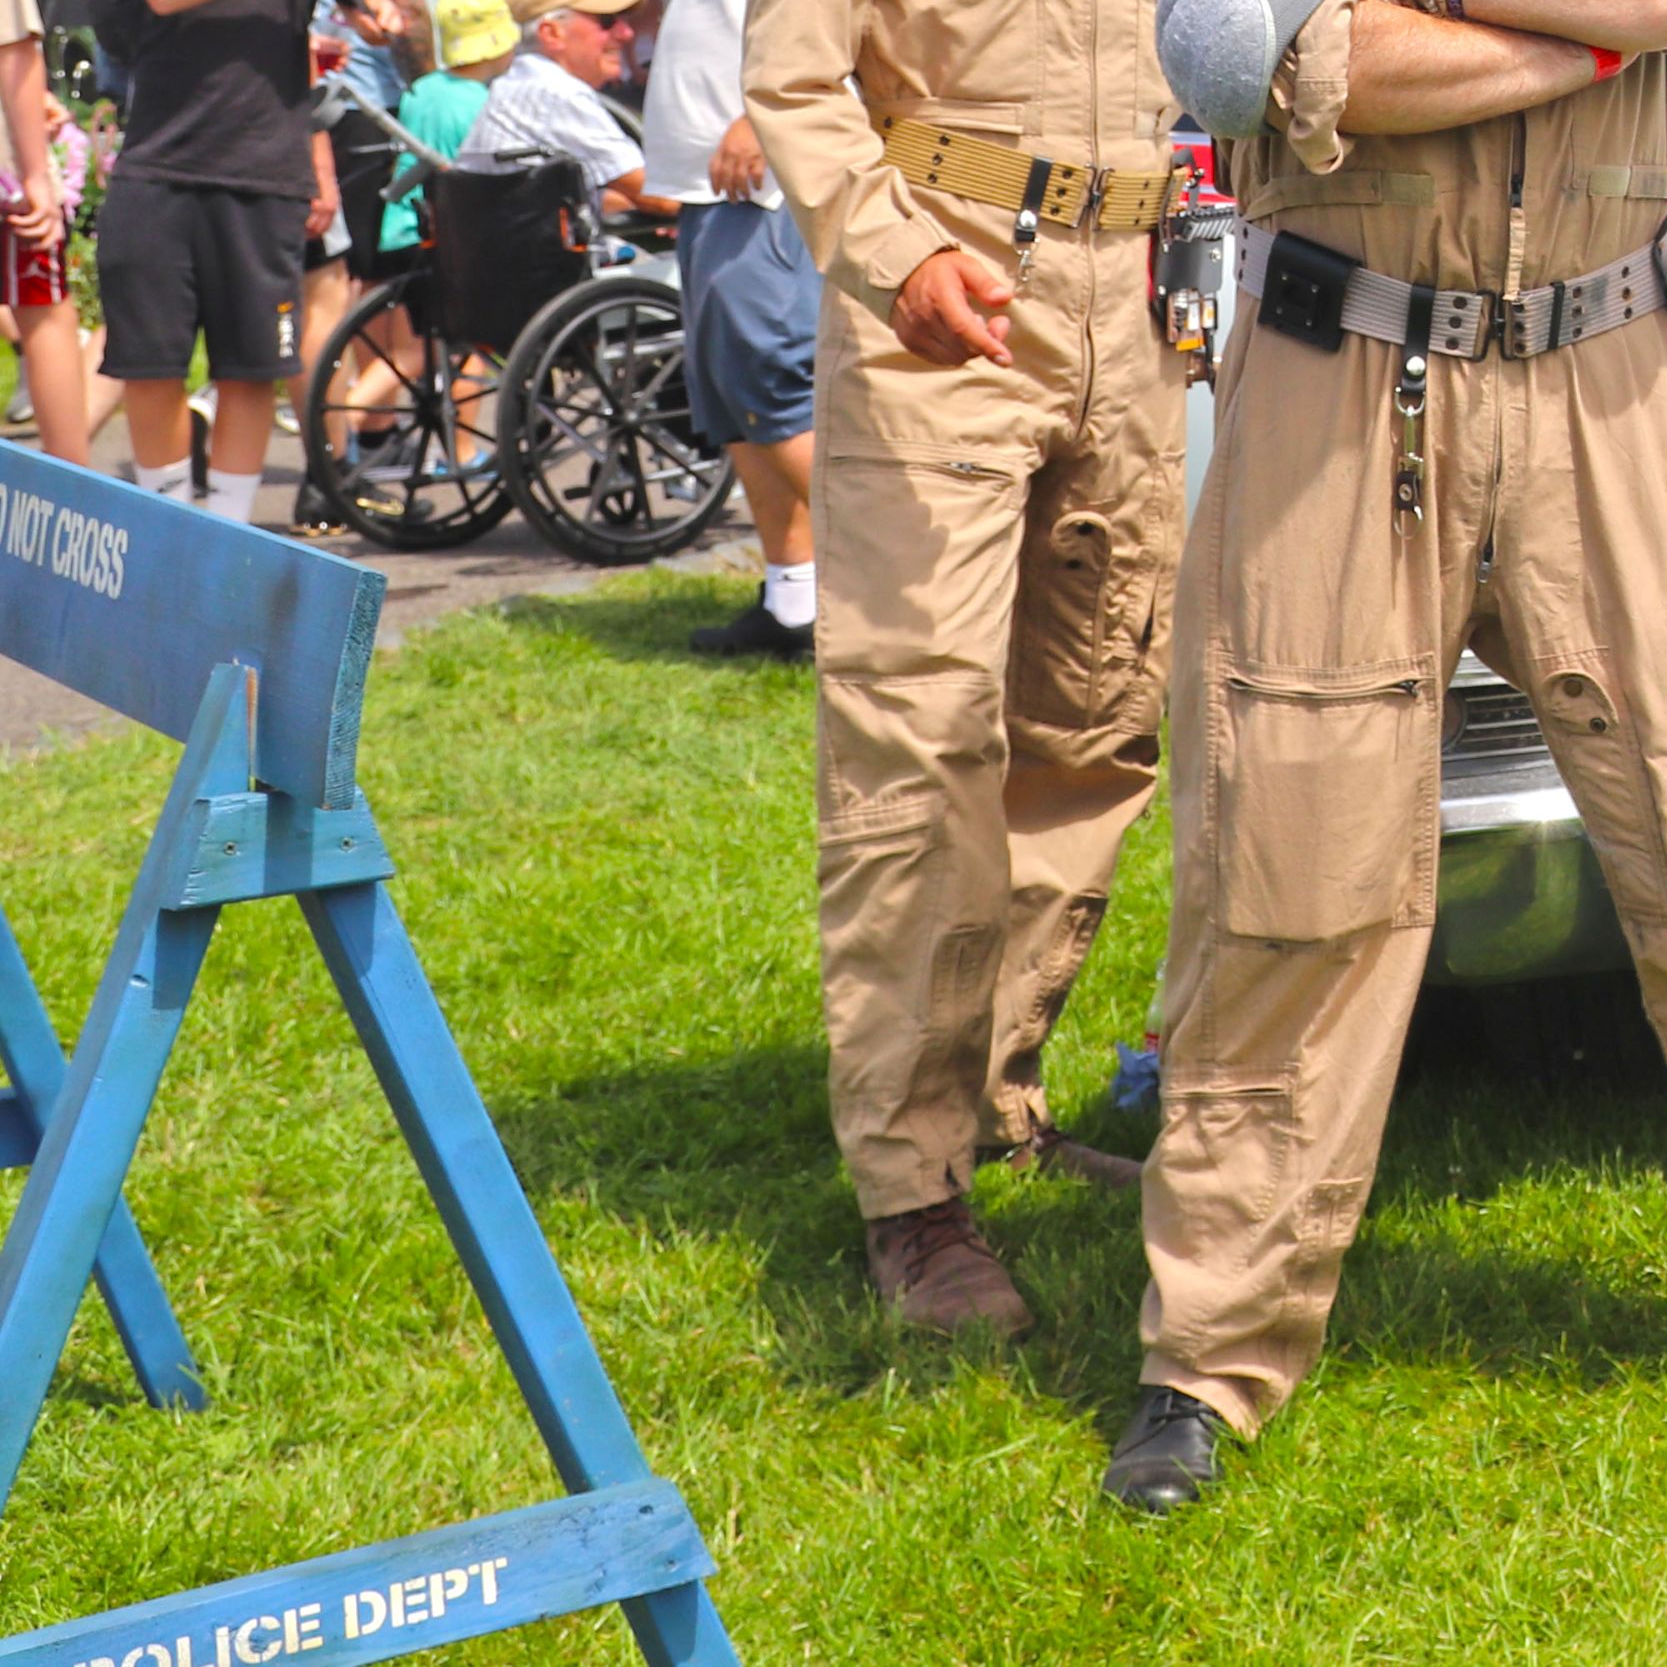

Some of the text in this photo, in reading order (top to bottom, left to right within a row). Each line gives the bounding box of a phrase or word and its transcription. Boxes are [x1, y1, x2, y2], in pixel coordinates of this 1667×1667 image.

[6, 489, 55, 566] NOT
[51, 507, 129, 600] CROSS
[343, 1557, 508, 1640] DEPT
